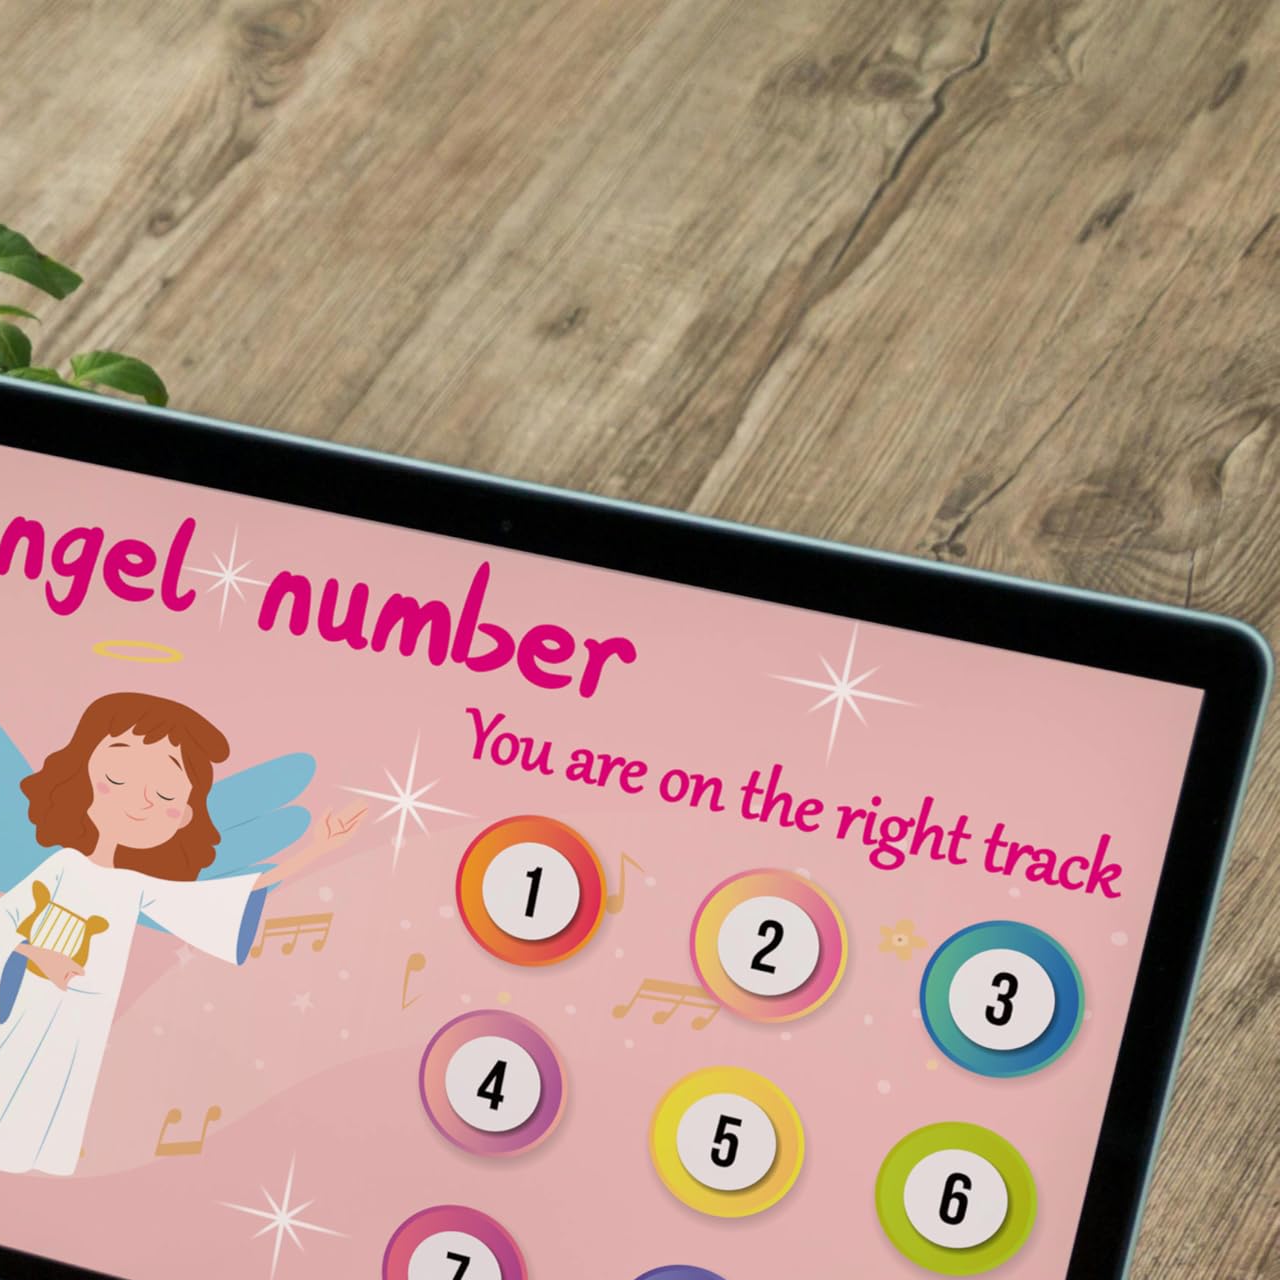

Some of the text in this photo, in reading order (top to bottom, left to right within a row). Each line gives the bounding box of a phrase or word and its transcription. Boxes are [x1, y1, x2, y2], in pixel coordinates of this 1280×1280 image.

[257, 562, 636, 698] number
[466, 708, 1121, 898] You are on the right track
[526, 868, 542, 917] 1
[751, 920, 783, 973] 2
[986, 973, 1018, 1025] 3
[477, 1061, 506, 1110] 4
[711, 1115, 741, 1167] 5
[940, 1173, 971, 1224] 6
